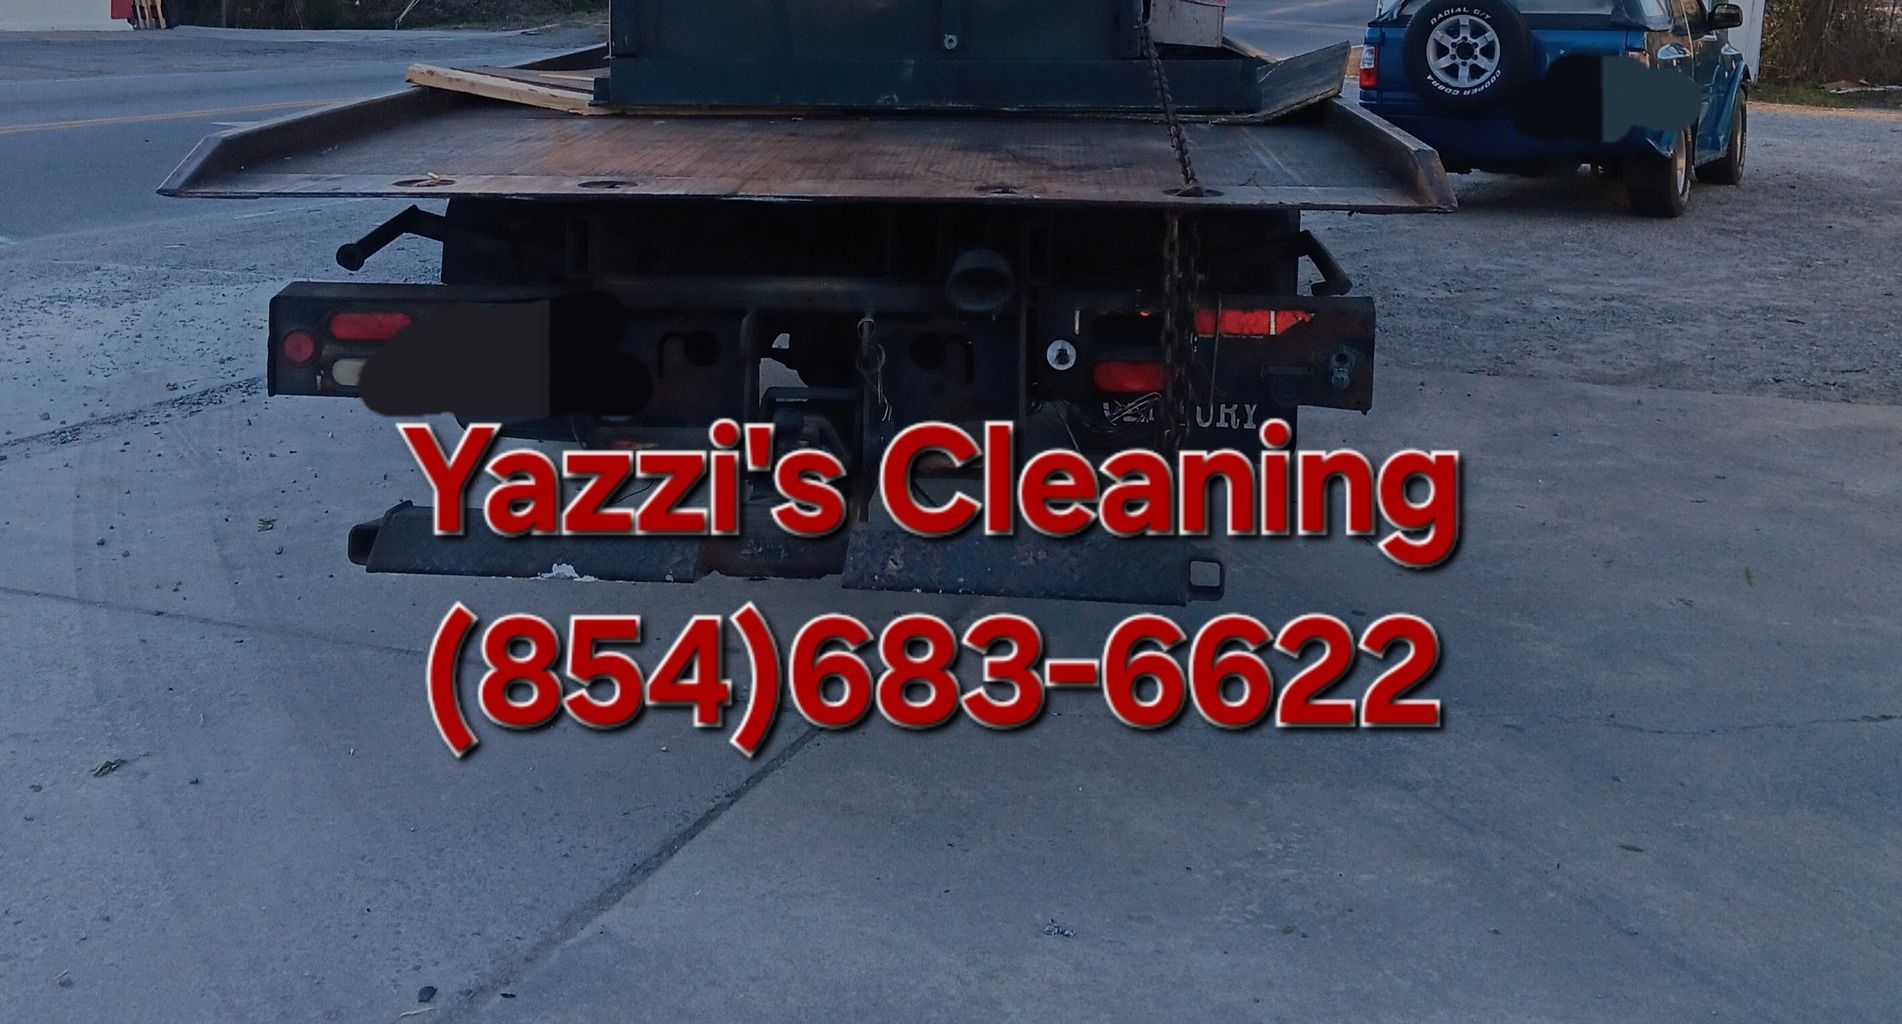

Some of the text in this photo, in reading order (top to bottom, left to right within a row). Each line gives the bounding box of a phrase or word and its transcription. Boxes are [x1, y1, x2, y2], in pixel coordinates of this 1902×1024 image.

[1430, 7, 1469, 25] RADIAL
[1427, 70, 1502, 96] COOPER COBRA
